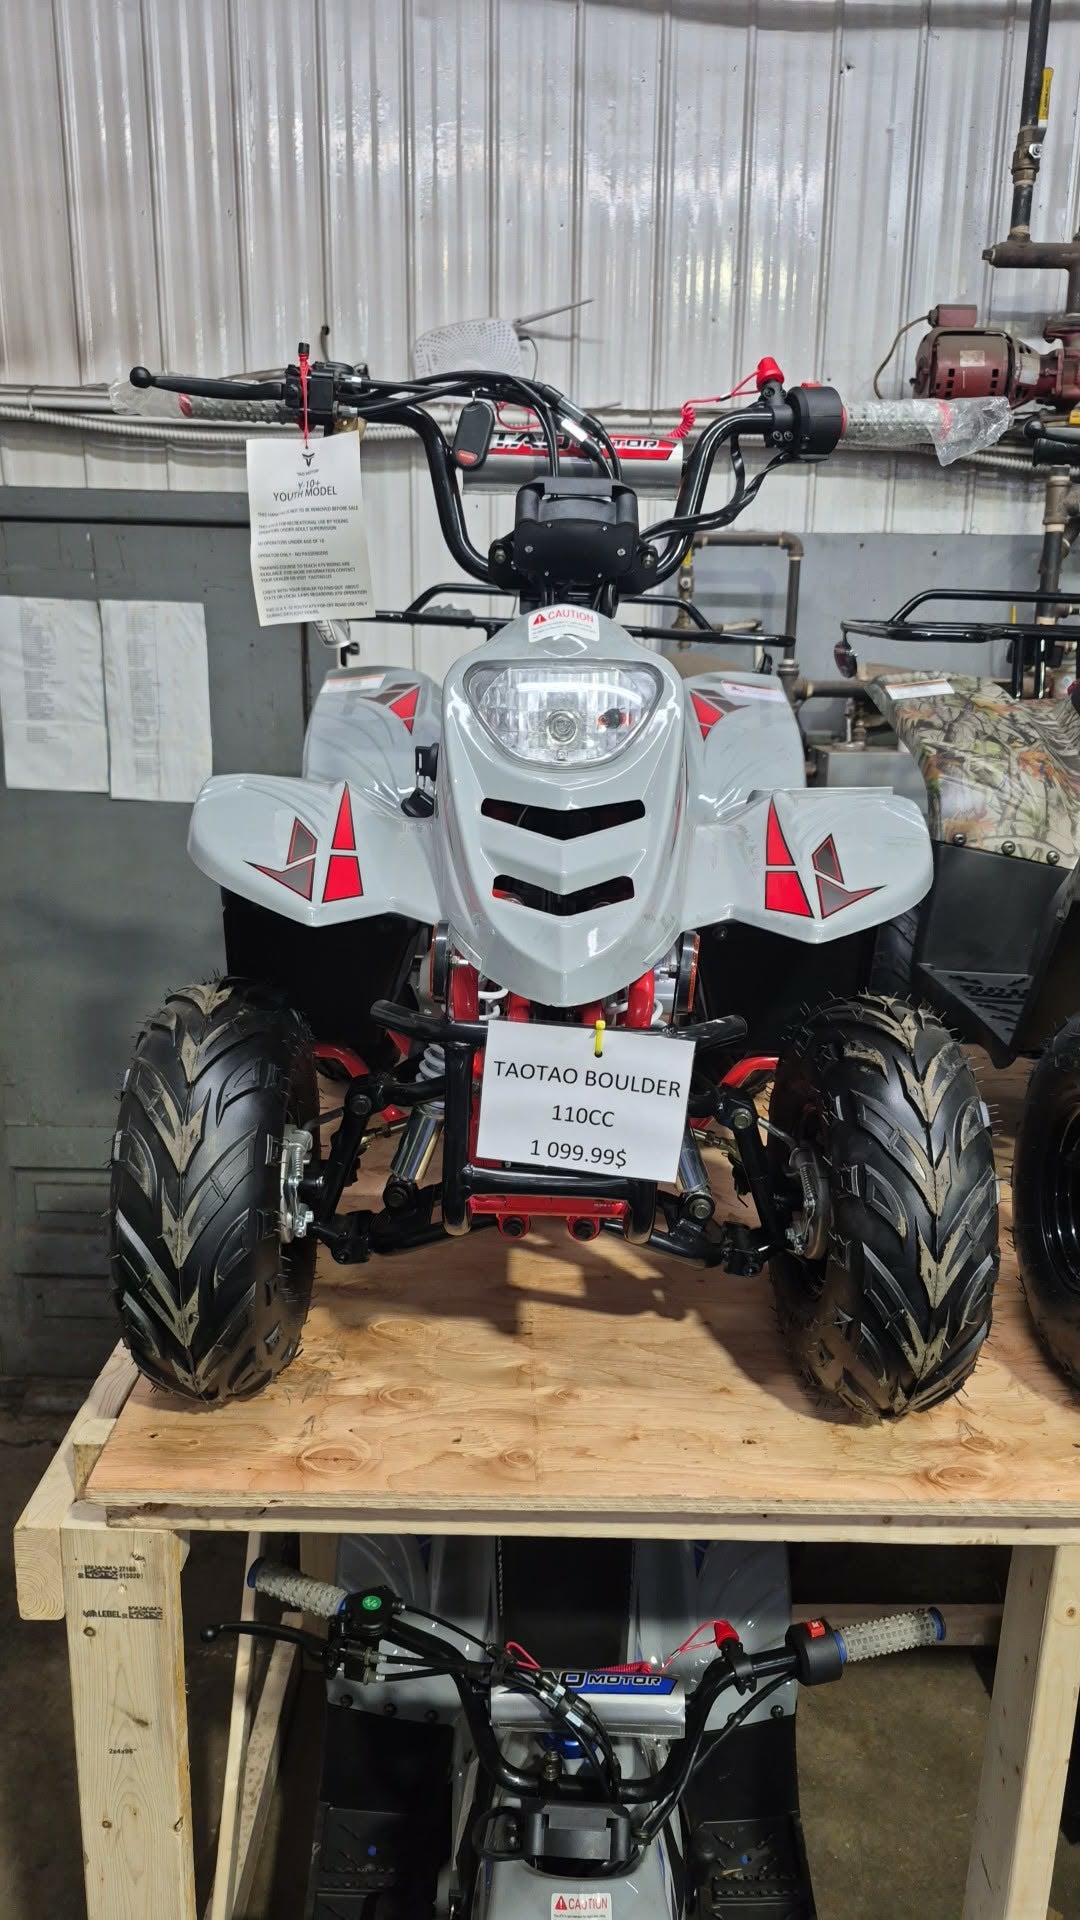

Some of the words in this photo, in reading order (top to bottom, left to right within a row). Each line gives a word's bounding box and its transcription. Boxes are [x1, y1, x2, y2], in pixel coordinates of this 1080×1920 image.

[273, 491, 304, 502] YOUTH
[305, 486, 338, 498] MODEL
[547, 609, 594, 623] CAUTION
[493, 1060, 579, 1085] TAOTAO
[584, 1069, 682, 1098] BOULDER
[551, 1104, 616, 1128] 110CC
[546, 1141, 628, 1170] 099.99$
[98, 1610, 121, 1619] LEBEL
[587, 1673, 662, 1687] MOTOR
[568, 1897, 608, 1910] CAUTION
